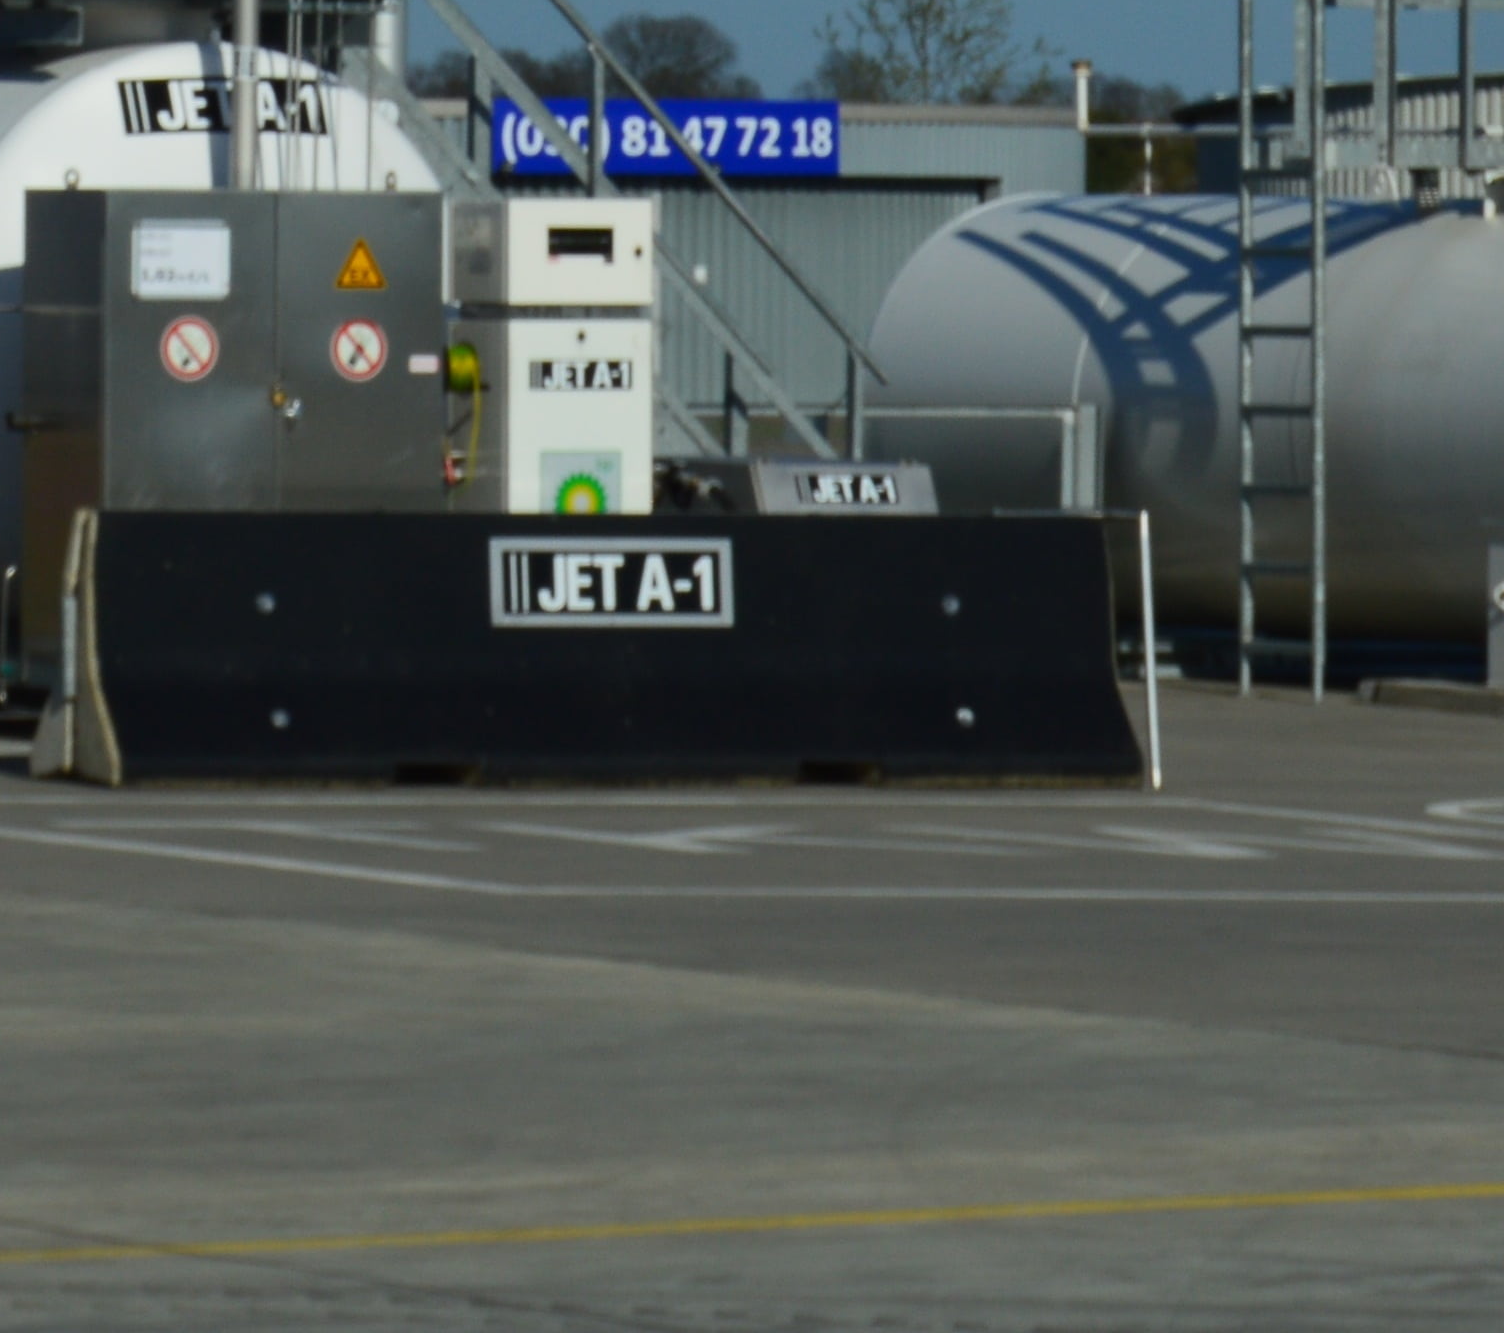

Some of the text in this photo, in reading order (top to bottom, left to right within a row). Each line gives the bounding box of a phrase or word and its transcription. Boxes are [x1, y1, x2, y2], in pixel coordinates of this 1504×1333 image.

[155, 79, 234, 131] JET
[620, 115, 671, 158] 81
[681, 116, 728, 158] 47
[734, 117, 781, 159] 72
[792, 117, 833, 159] 18
[543, 361, 630, 390] JET A-1
[812, 473, 897, 504] JET A-1
[537, 552, 715, 613] JET A-1
